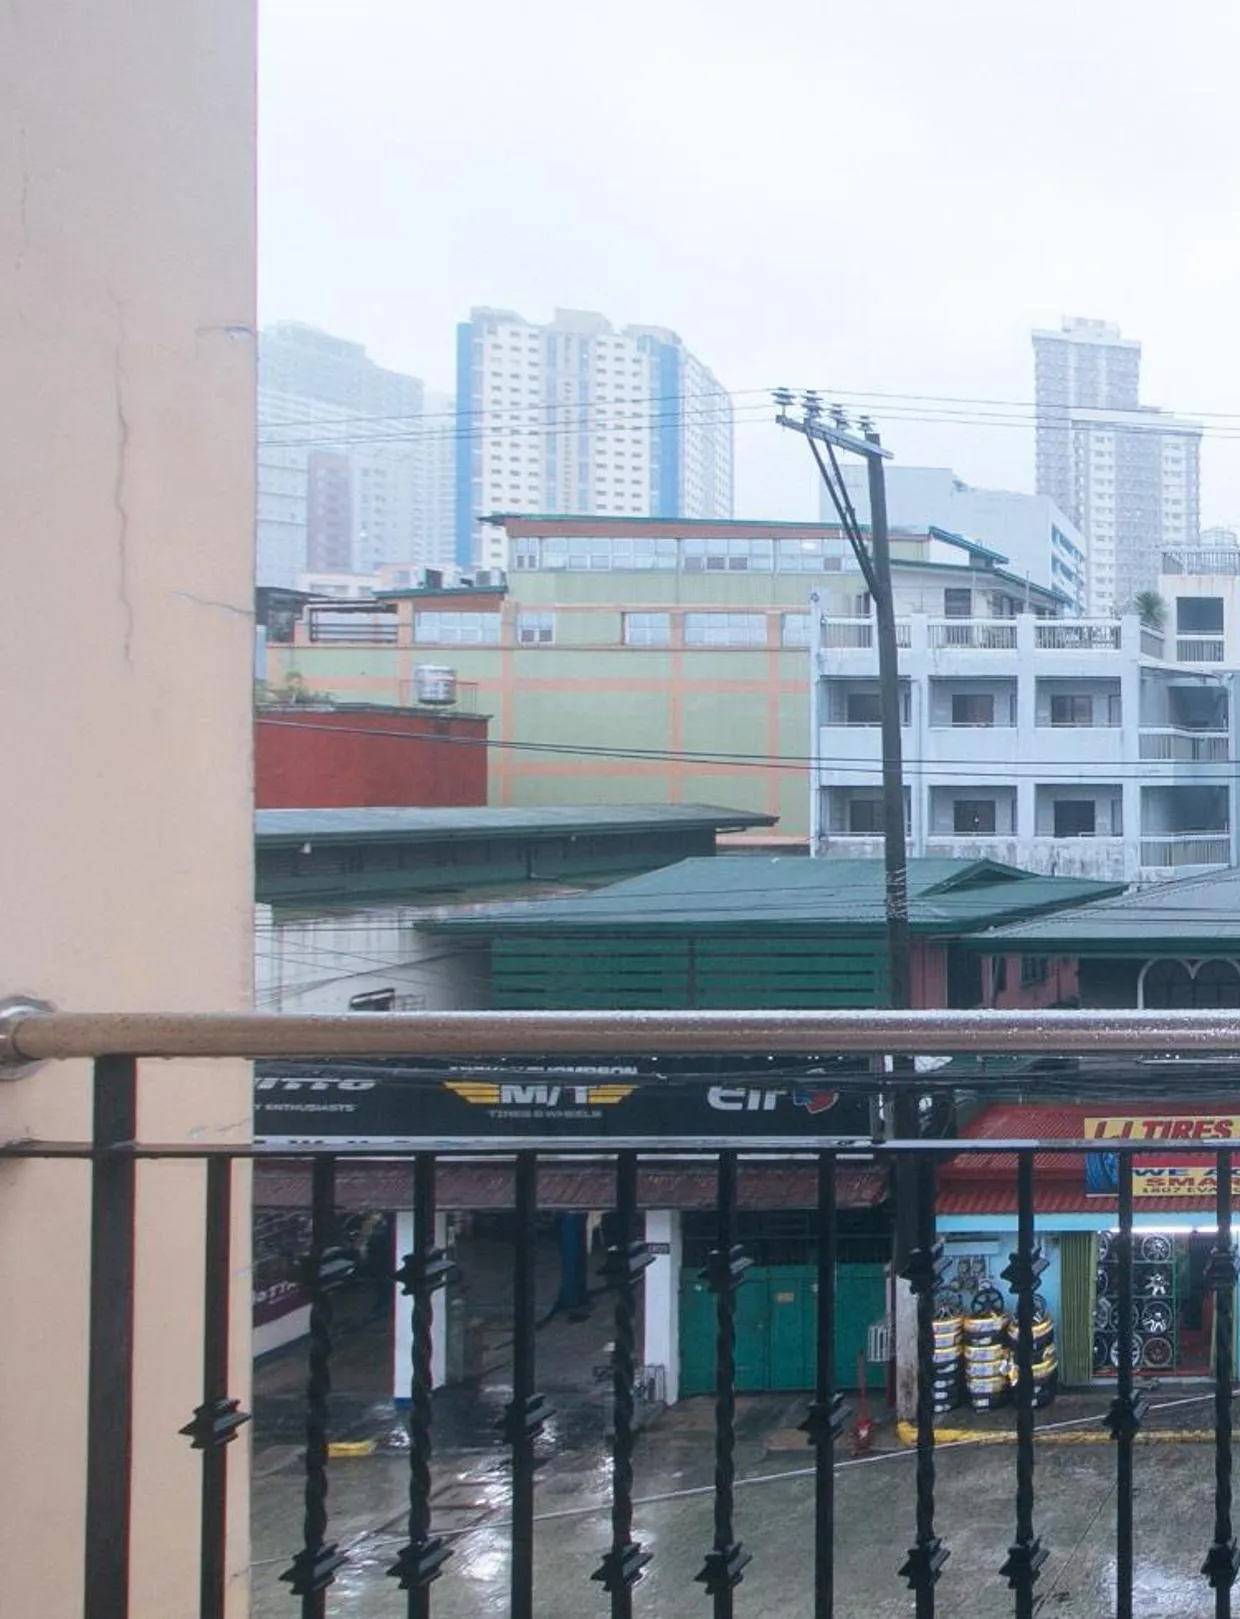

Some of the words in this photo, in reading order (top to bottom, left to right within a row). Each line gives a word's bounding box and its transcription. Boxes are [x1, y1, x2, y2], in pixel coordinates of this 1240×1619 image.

[253, 1077, 376, 1091] ITTO
[265, 1103, 357, 1113] ENTHUSIASTS
[1142, 1119, 1234, 1138] TIRES
